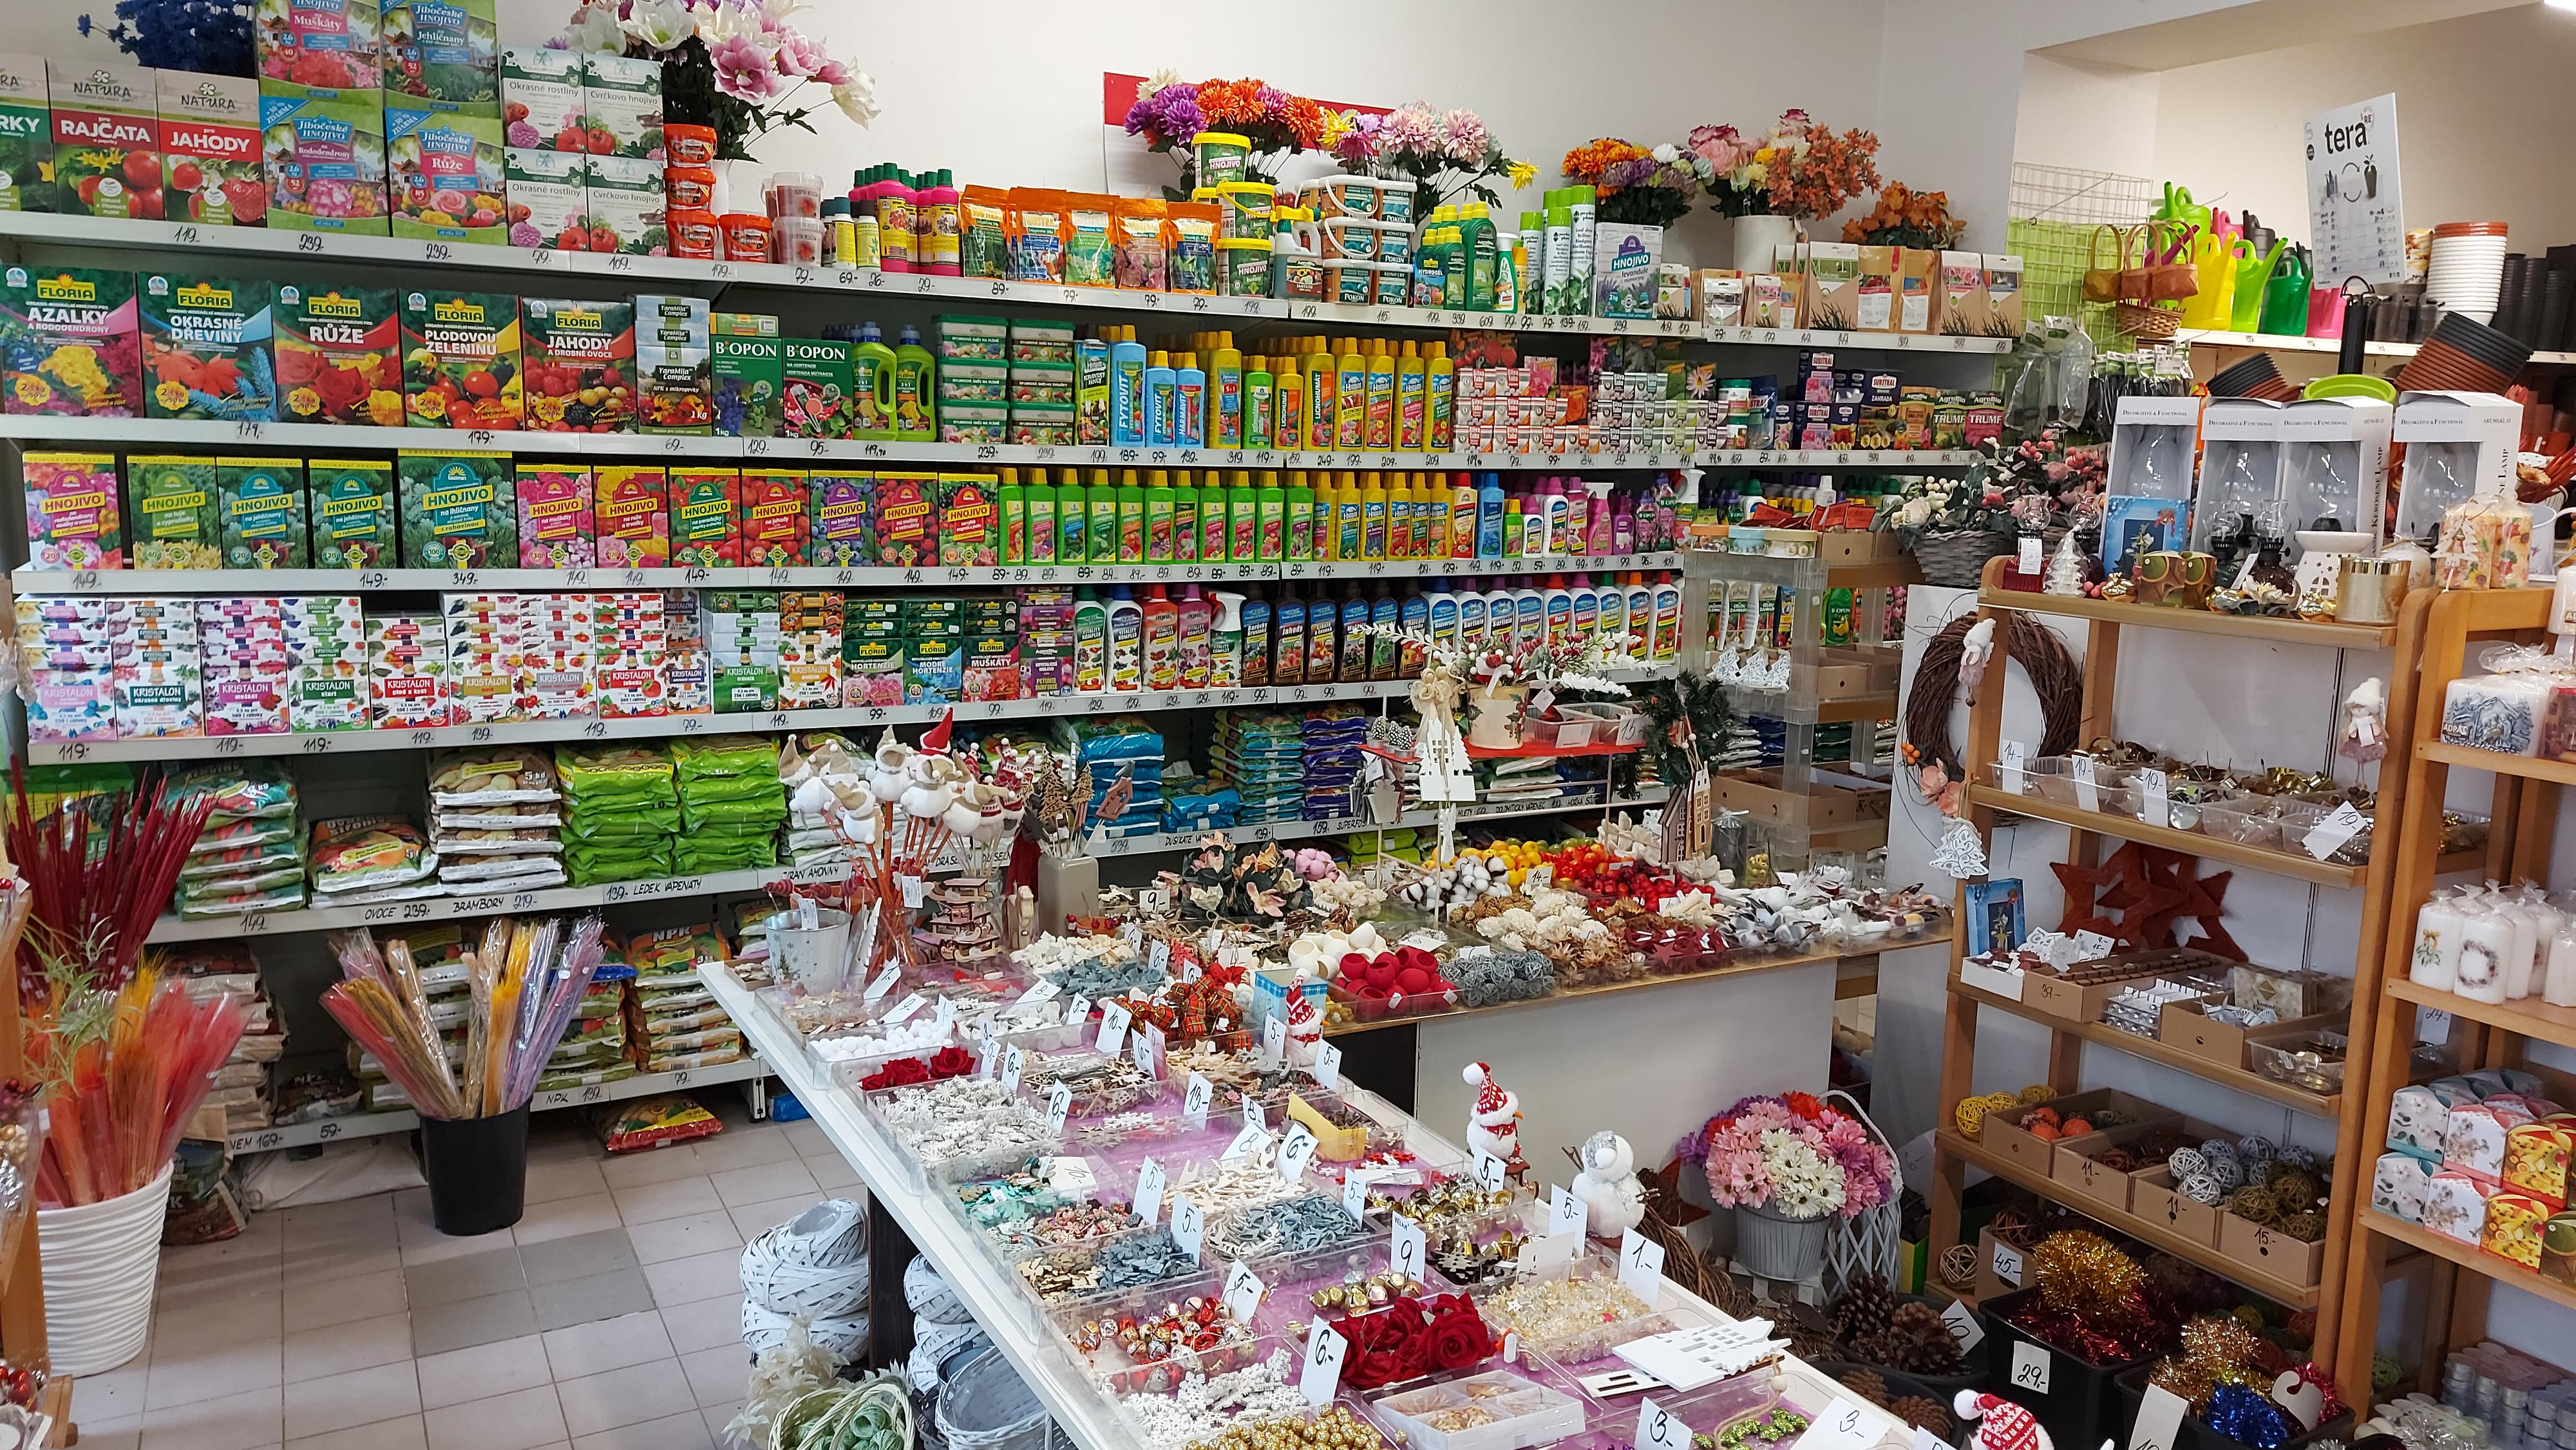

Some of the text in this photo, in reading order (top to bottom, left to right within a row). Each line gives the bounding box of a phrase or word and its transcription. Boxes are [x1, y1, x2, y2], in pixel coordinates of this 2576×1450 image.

[294, 14, 341, 32] Muškáty
[420, 14, 460, 26] HNOJIVO
[417, 30, 465, 45] Jehličnany
[73, 82, 131, 98] NATURA
[509, 81, 578, 97] Okrasné rostliny
[182, 94, 236, 109] NATURA
[591, 91, 658, 105] Cvrčkovo hnojivo
[2363, 115, 2372, 123] RE
[61, 118, 151, 143] RAJČATA
[303, 130, 345, 140] HNOJIVO
[171, 132, 251, 153] JAHODY
[2325, 122, 2367, 155] tera
[427, 140, 467, 152] HNOJIVO
[298, 147, 350, 160] Rododendrony
[1210, 160, 1240, 170] HNOJIVO
[513, 184, 580, 197] Okrasné rostliny
[594, 191, 660, 203] Cvrčkovo hnojivo
[1613, 254, 1650, 270] HNOJIVO
[1238, 265, 1267, 275] HNOJIVO
[1621, 268, 1649, 278] levandule
[39, 287, 93, 299] FLORIA
[180, 295, 231, 307] FLORIA
[1383, 296, 1403, 304] POKON
[28, 308, 108, 324] AZALKY
[310, 304, 359, 316] FLORIA
[437, 310, 482, 321] FLORIA
[35, 323, 109, 334] RODODENDRONY
[170, 316, 242, 330] OKRASNÉ
[557, 317, 600, 327] FLORIA
[171, 328, 242, 343] DŘEVINY
[310, 324, 364, 344] RŮŽE
[425, 330, 497, 343] PLODOVOU
[425, 341, 497, 355] ZELENINU
[547, 337, 611, 350] JAHODY
[553, 349, 585, 357] DROBNÉ
[1873, 377, 1897, 388] SUBSTRAL
[1119, 374, 1128, 429] FYTOVIT
[1938, 396, 1965, 404] AgroBio
[697, 411, 706, 420] kg
[1934, 415, 1965, 424] TRUMF
[1969, 415, 2002, 424] TRUMF
[715, 428, 729, 437] 1kg
[786, 429, 799, 438] 1kg
[2498, 449, 2508, 479] LAMP
[44, 495, 101, 511] HNOJIVO
[147, 495, 201, 510] HNOJIVO
[428, 489, 489, 507] HNOJIVO
[327, 498, 378, 514] HNOJIVO
[533, 501, 579, 514] HNOJIVO
[610, 501, 655, 515] HNOJIVO
[685, 502, 728, 516] HNOJIVO
[755, 504, 798, 517] HNOJIVO
[824, 504, 862, 517] HNOJIVO
[888, 505, 926, 518] HNOJIVO
[951, 506, 987, 520] HNOJIVO
[1282, 626, 1303, 635] Jahody
[851, 662, 895, 670] HORTENZIE
[971, 657, 1010, 667] MUŠKÁTY
[612, 670, 652, 681] KRISTALON
[672, 670, 702, 678] KRISTALON
[727, 667, 763, 677] KRISTALON
[222, 684, 268, 694] KRISTALON
[305, 681, 350, 691] KRISTALON
[387, 679, 430, 689] KRISTALON
[133, 687, 181, 697] KRISTALON
[632, 883, 661, 896] LEDEK
[453, 898, 504, 913] BRAMBORY
[365, 907, 395, 920] OVOCE
[652, 925, 692, 941] NPK
[546, 1093, 569, 1105] NPK
